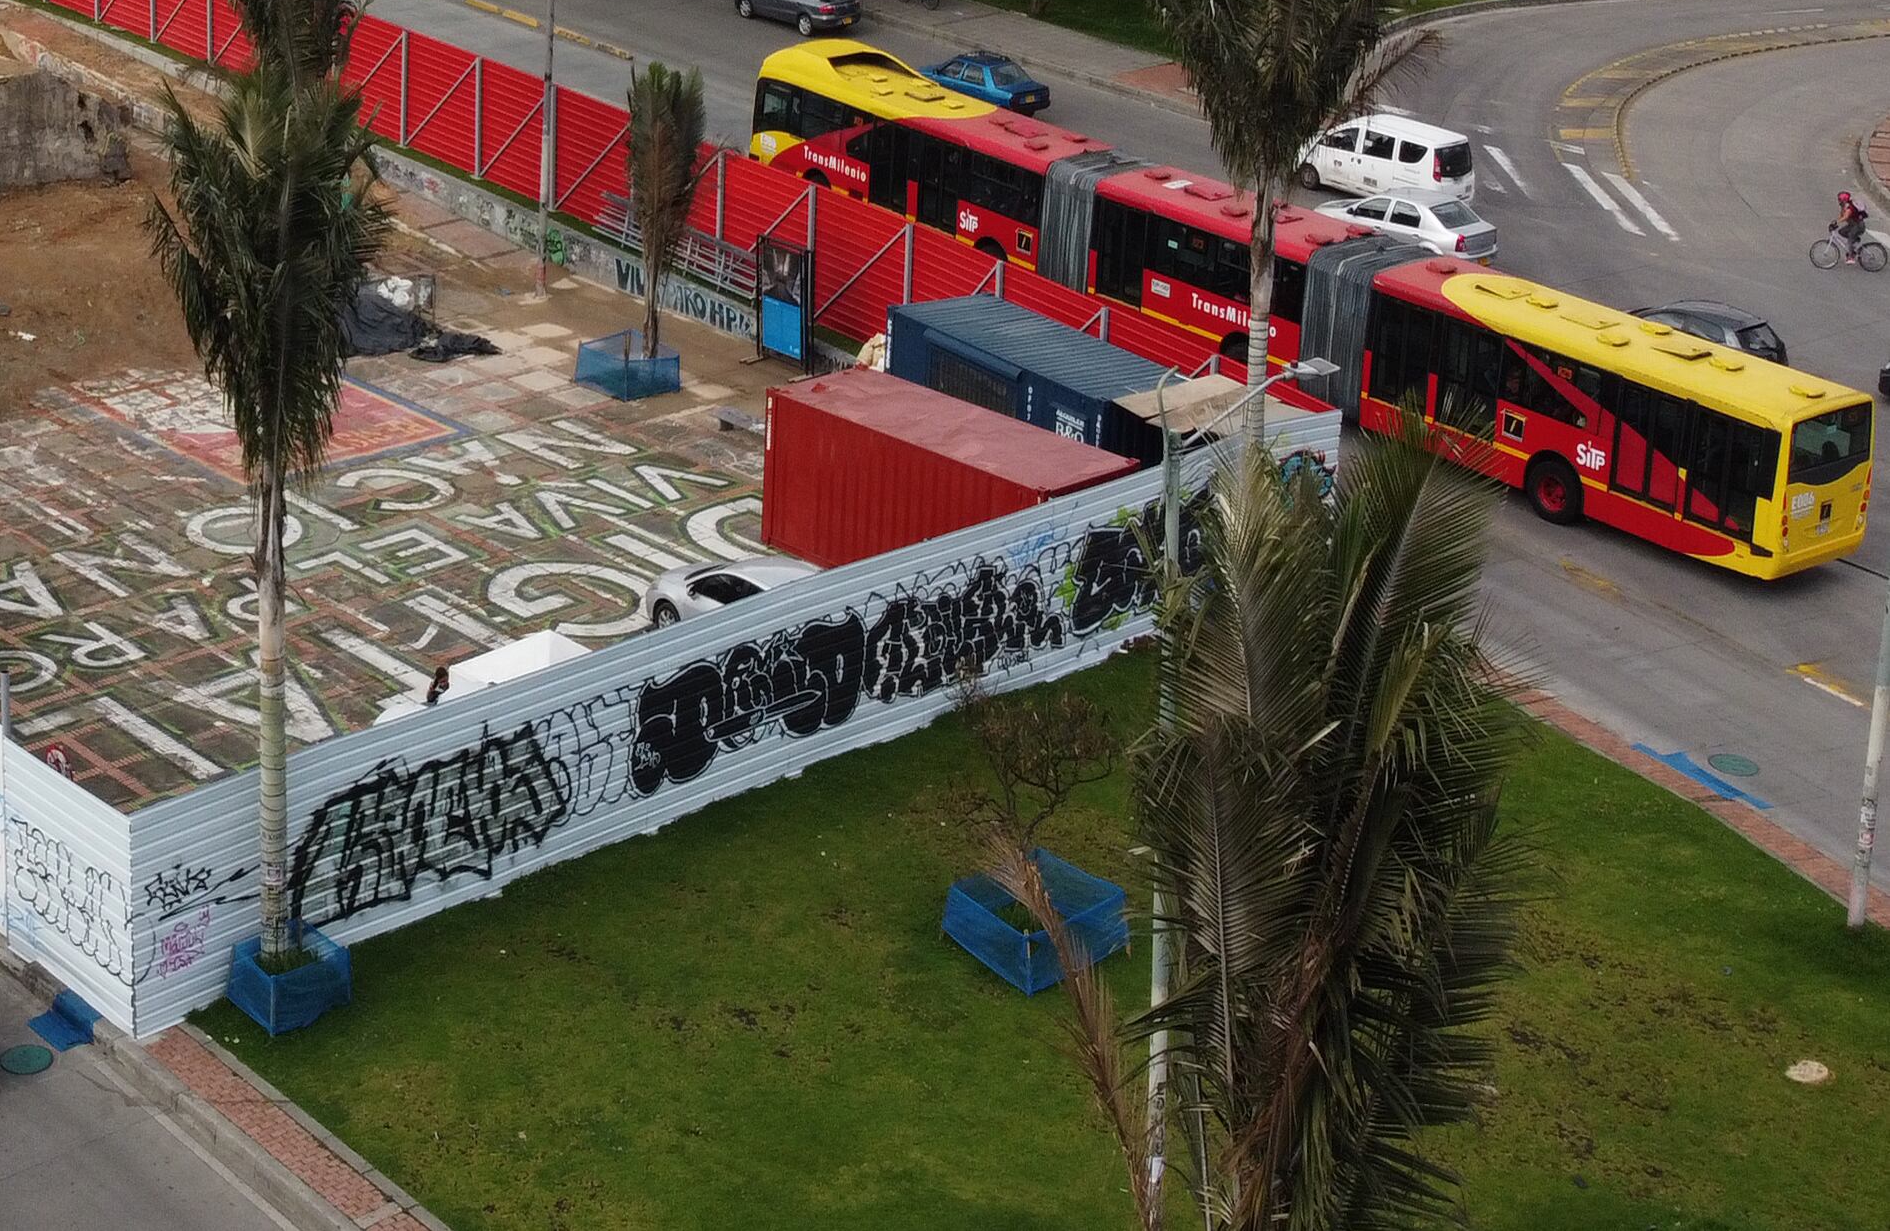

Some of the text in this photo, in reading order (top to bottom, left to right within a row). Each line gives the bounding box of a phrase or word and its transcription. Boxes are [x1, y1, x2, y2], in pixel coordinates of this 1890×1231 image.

[803, 143, 867, 183] TransMilenio
[1191, 291, 1277, 339] TransMilo
[455, 463, 731, 540] VIVA
[294, 527, 470, 585] EL
